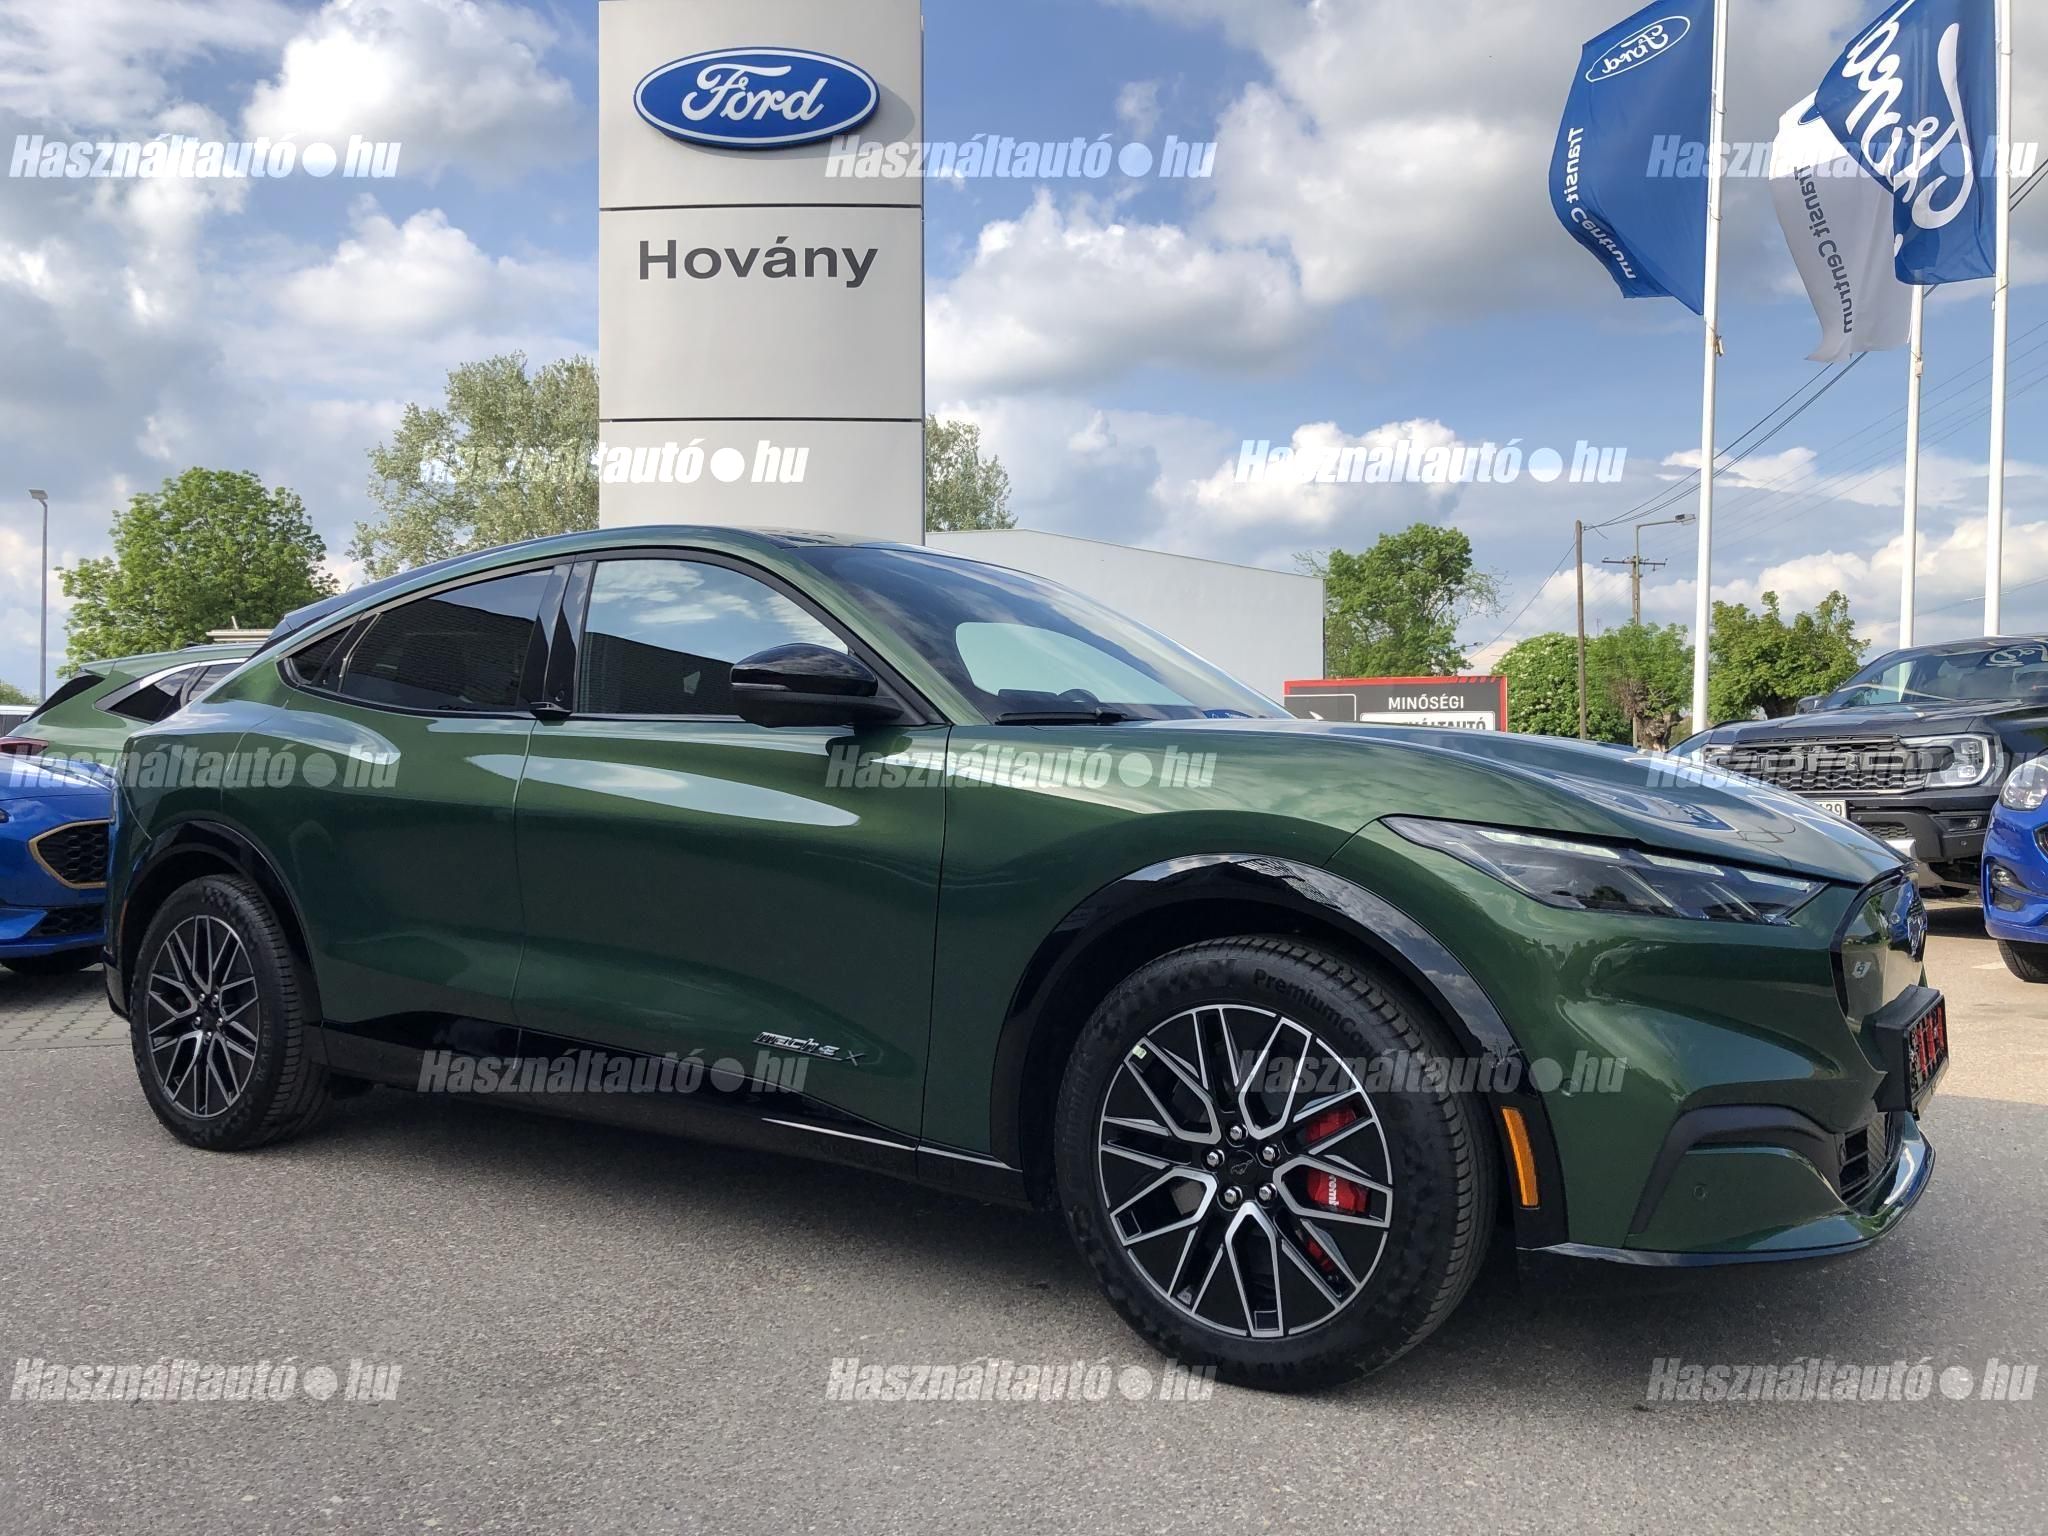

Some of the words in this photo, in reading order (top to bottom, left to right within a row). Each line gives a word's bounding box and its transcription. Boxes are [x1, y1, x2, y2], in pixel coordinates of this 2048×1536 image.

[681, 63, 828, 121] Ford
[639, 235, 879, 288] Hovány
[1388, 693, 1464, 710] MINŐSÉGI
